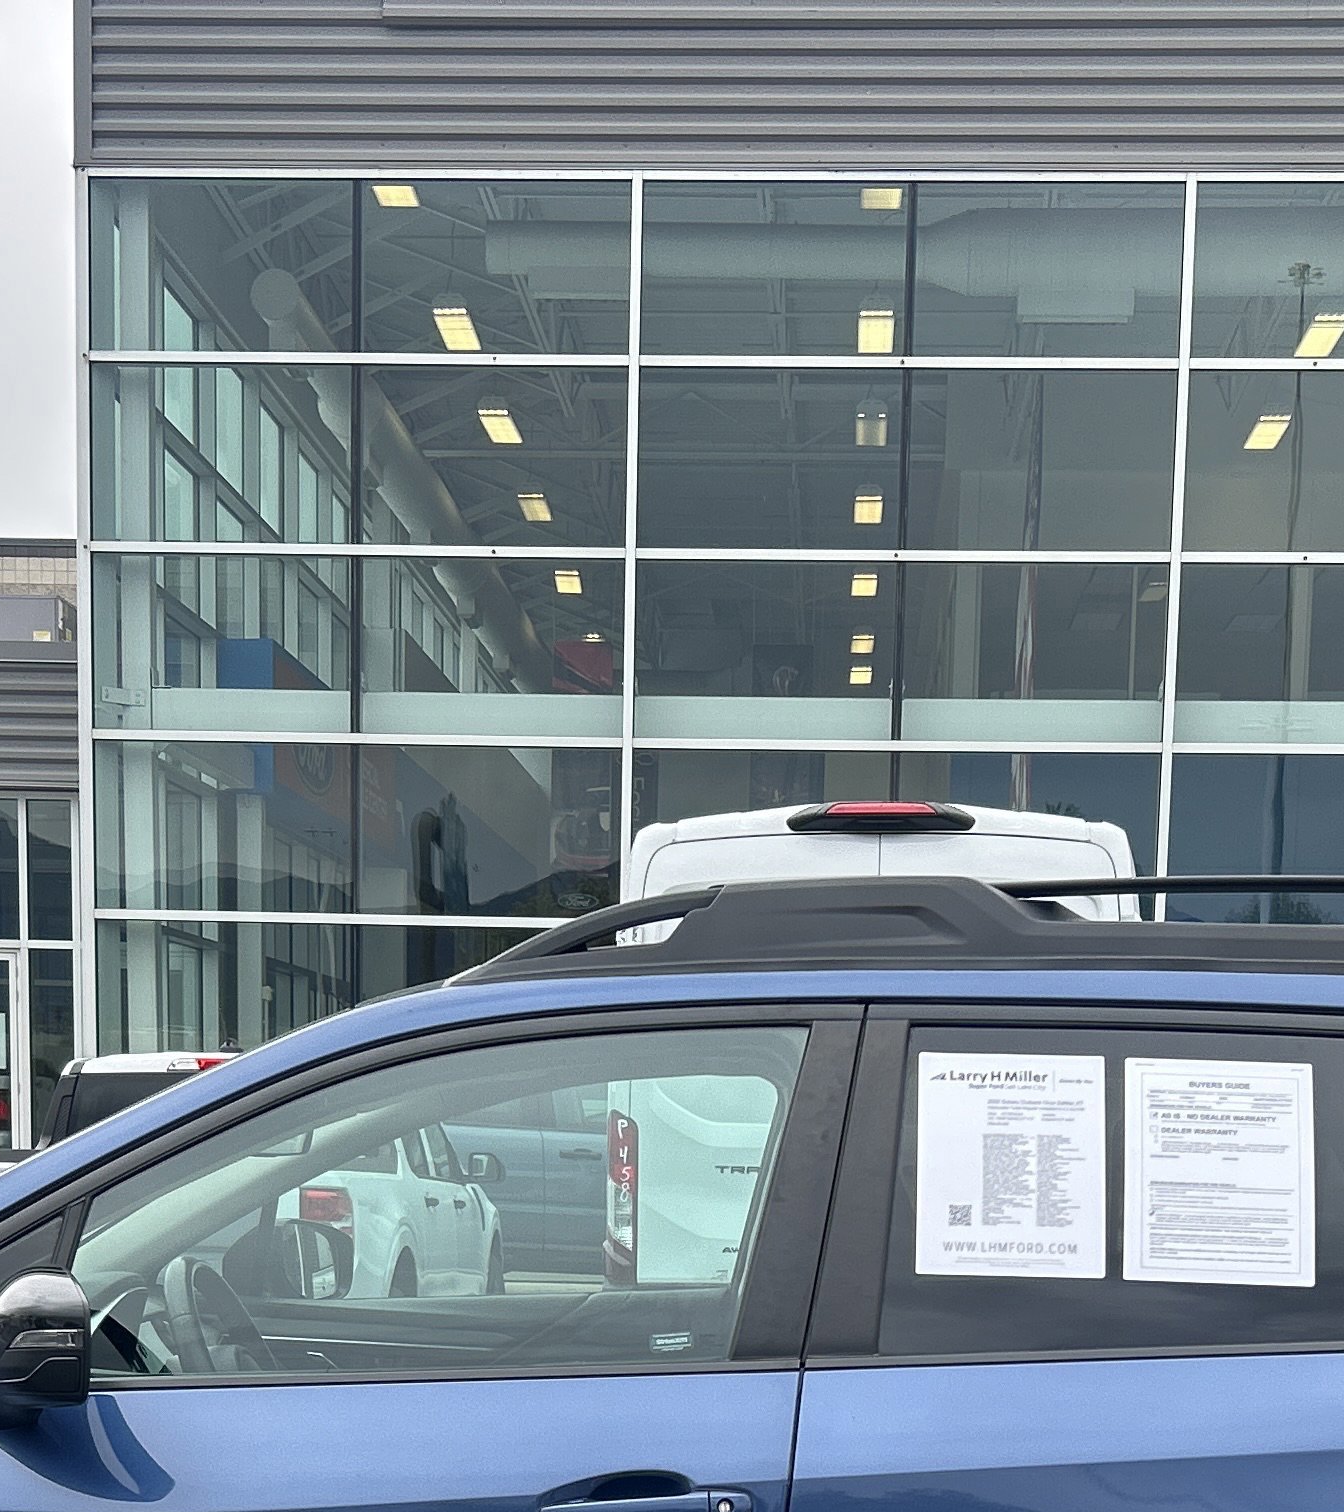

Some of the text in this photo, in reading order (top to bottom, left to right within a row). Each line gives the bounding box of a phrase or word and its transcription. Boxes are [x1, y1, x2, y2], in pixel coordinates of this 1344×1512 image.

[949, 1070, 988, 1084] Larry
[990, 1071, 1002, 1082] H
[1005, 1070, 1049, 1083] Miller
